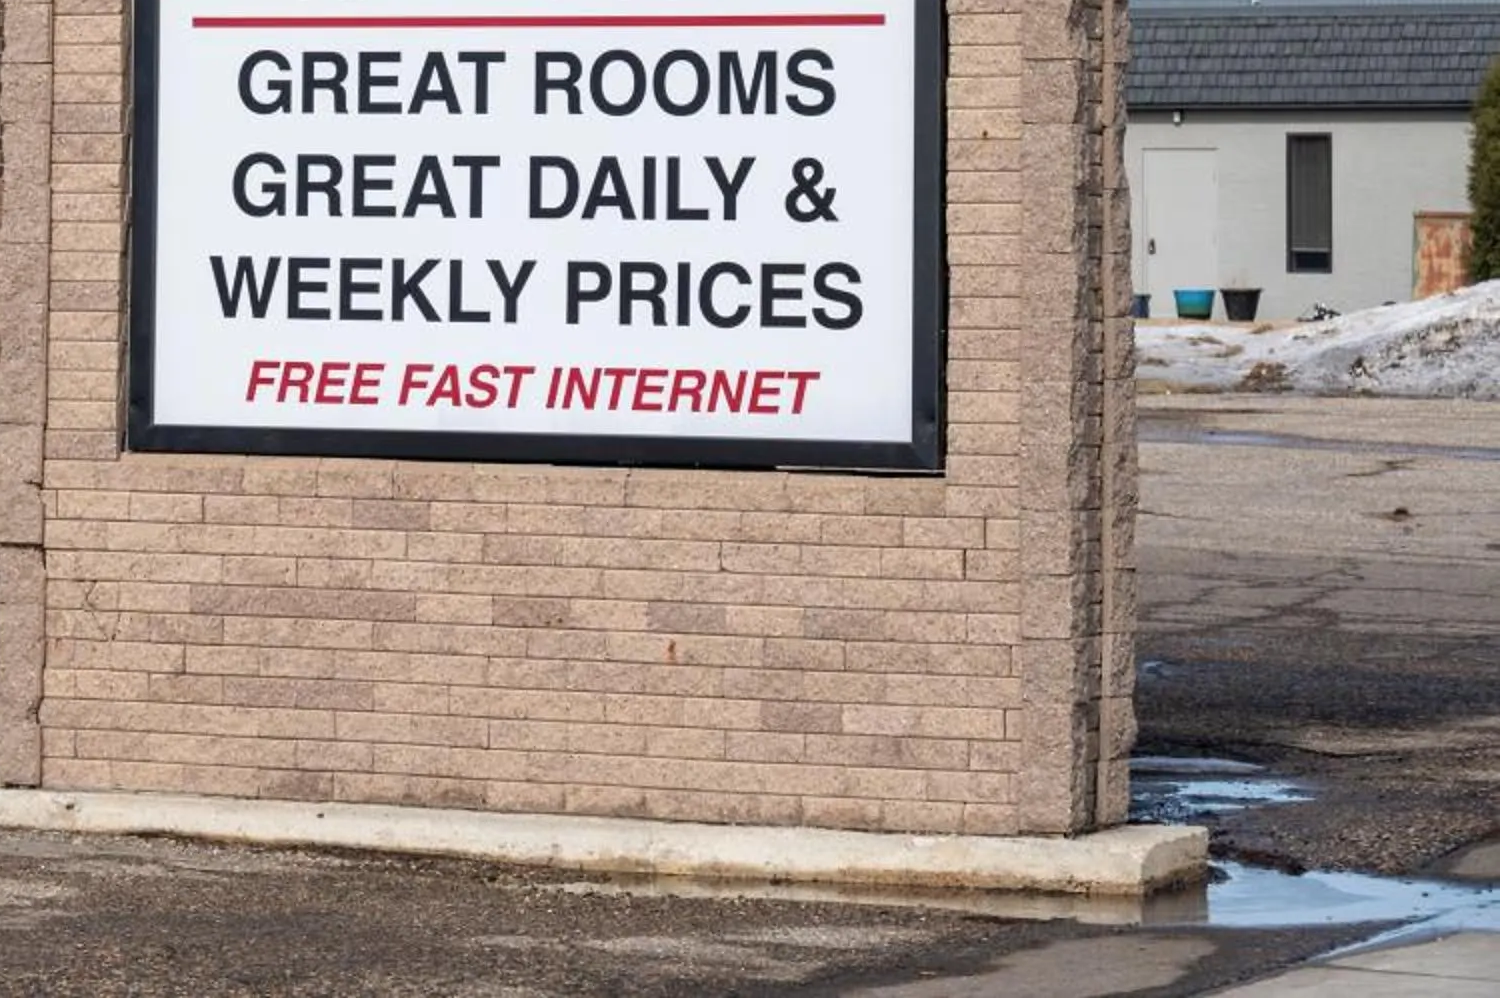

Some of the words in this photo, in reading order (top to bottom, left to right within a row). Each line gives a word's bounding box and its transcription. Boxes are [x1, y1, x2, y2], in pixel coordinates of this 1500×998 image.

[237, 49, 506, 116] GREAT
[534, 48, 837, 117] ROOMS
[232, 152, 501, 219] GREAT
[529, 155, 756, 221] DAILY
[785, 157, 840, 223] &
[209, 255, 537, 323] WEEKLY
[566, 260, 863, 331] PRICES
[246, 360, 385, 405] FREE
[398, 363, 535, 409] FAST
[545, 366, 821, 415] INTERNET
